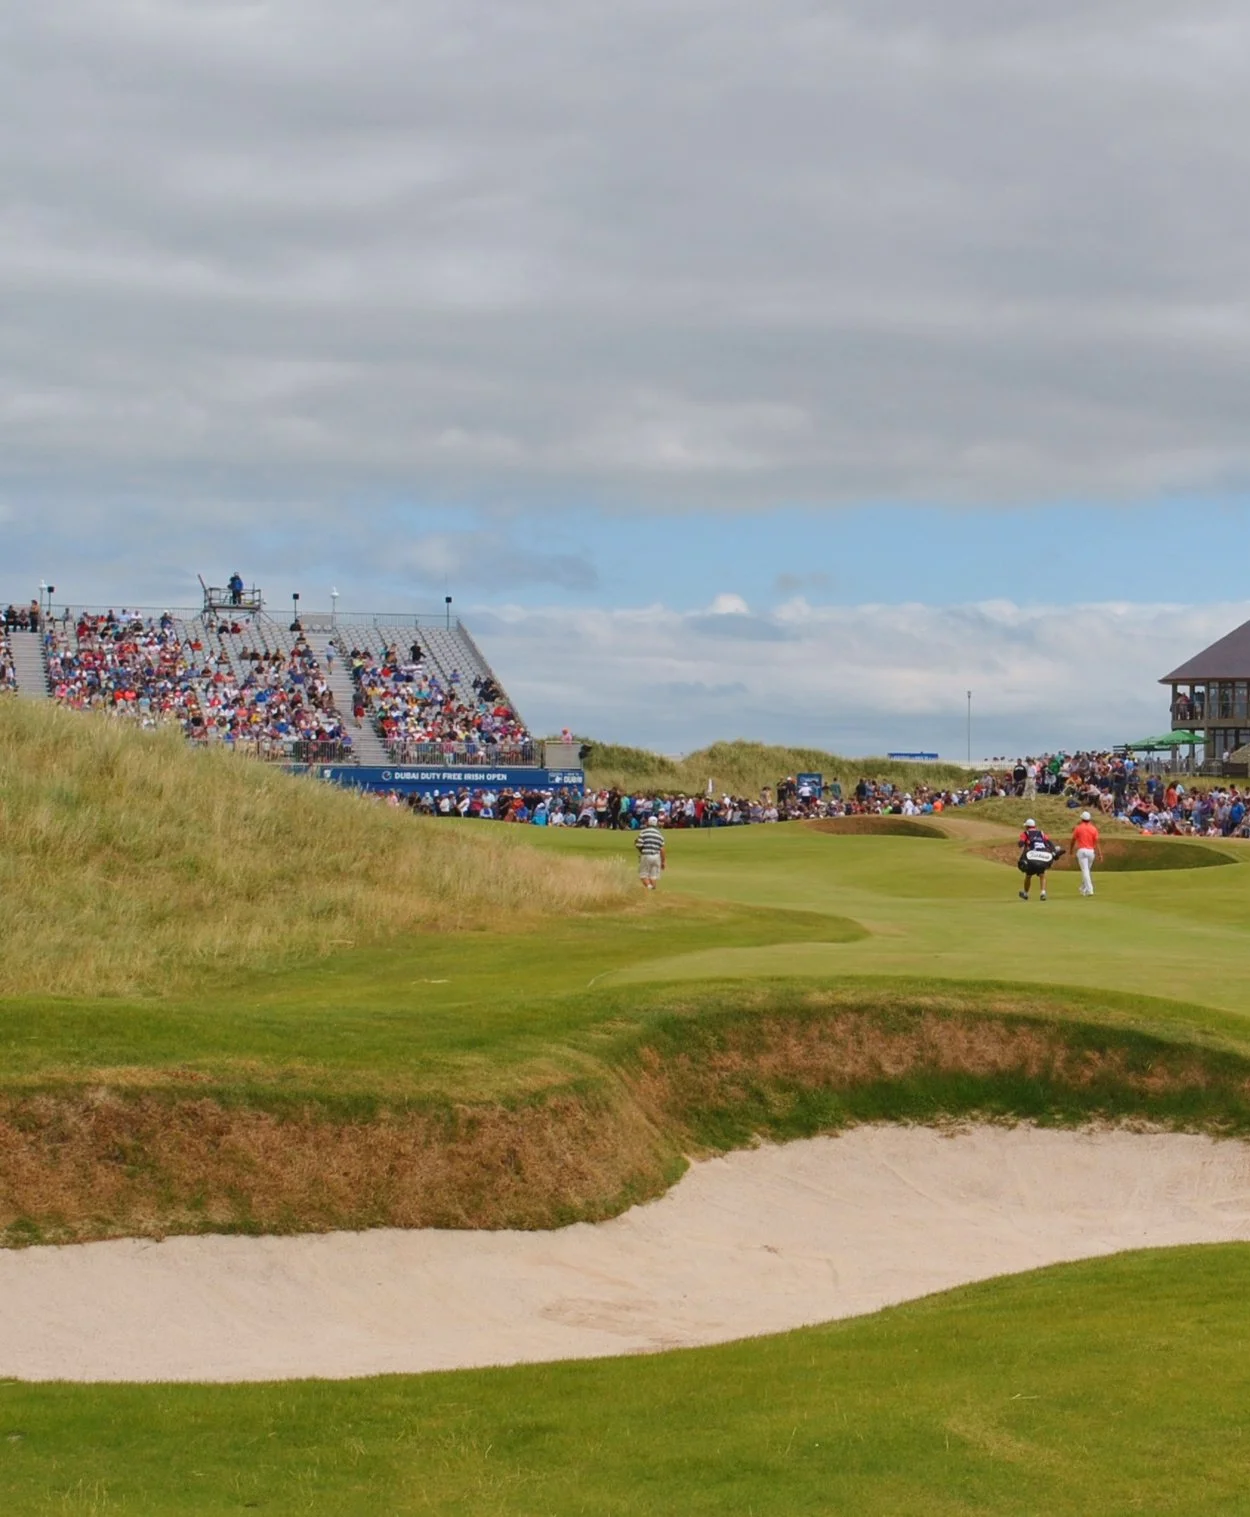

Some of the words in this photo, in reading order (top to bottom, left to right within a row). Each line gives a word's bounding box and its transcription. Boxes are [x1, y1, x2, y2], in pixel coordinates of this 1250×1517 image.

[394, 771, 419, 779] DUBAI
[420, 771, 441, 780] DUTY
[442, 772, 463, 780] FREE
[464, 773, 485, 781] IRISH
[486, 773, 508, 781] OPEN
